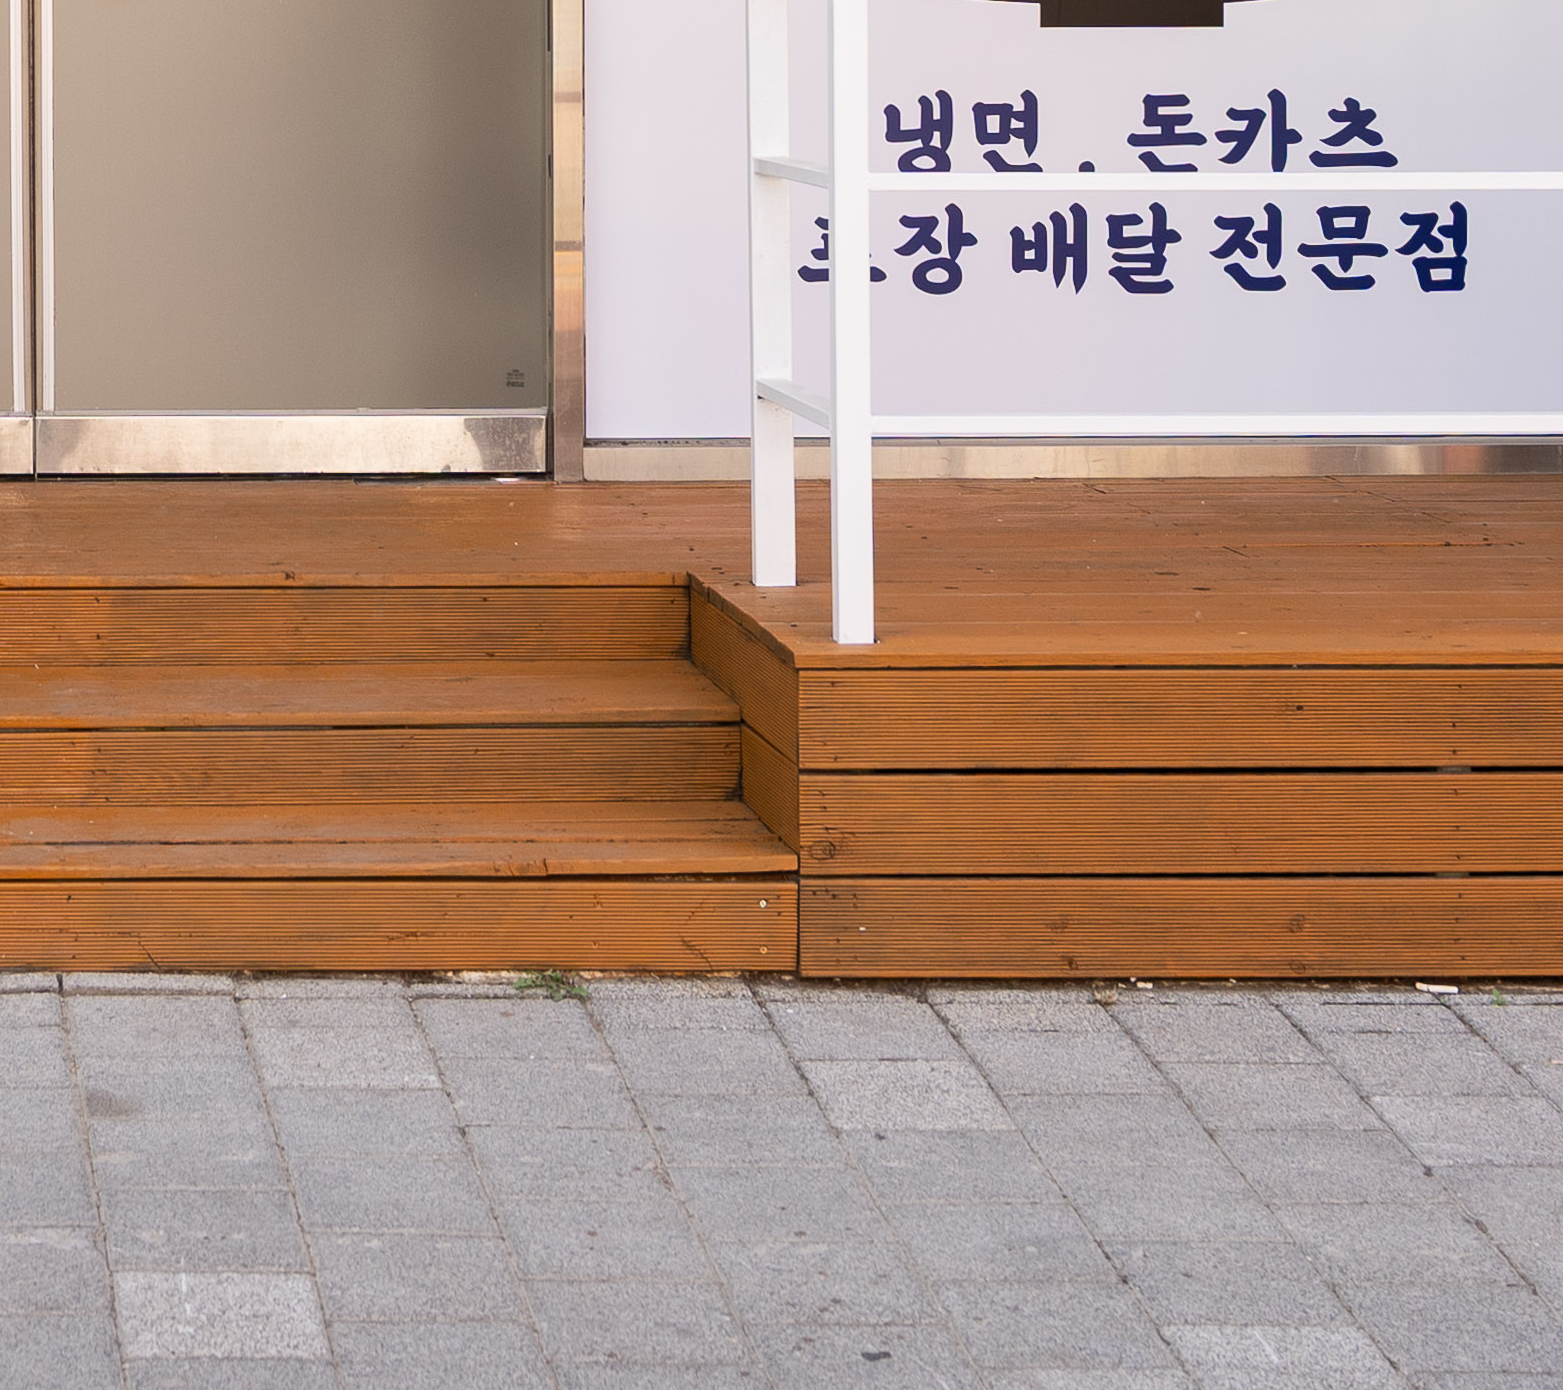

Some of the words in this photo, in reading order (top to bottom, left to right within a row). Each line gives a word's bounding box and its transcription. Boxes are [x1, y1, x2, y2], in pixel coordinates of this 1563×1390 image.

[883, 89, 1044, 172] 냉면
[1126, 88, 1399, 172] 돈카츠
[1010, 202, 1182, 294] 배달
[1211, 201, 1468, 293] 전문점
